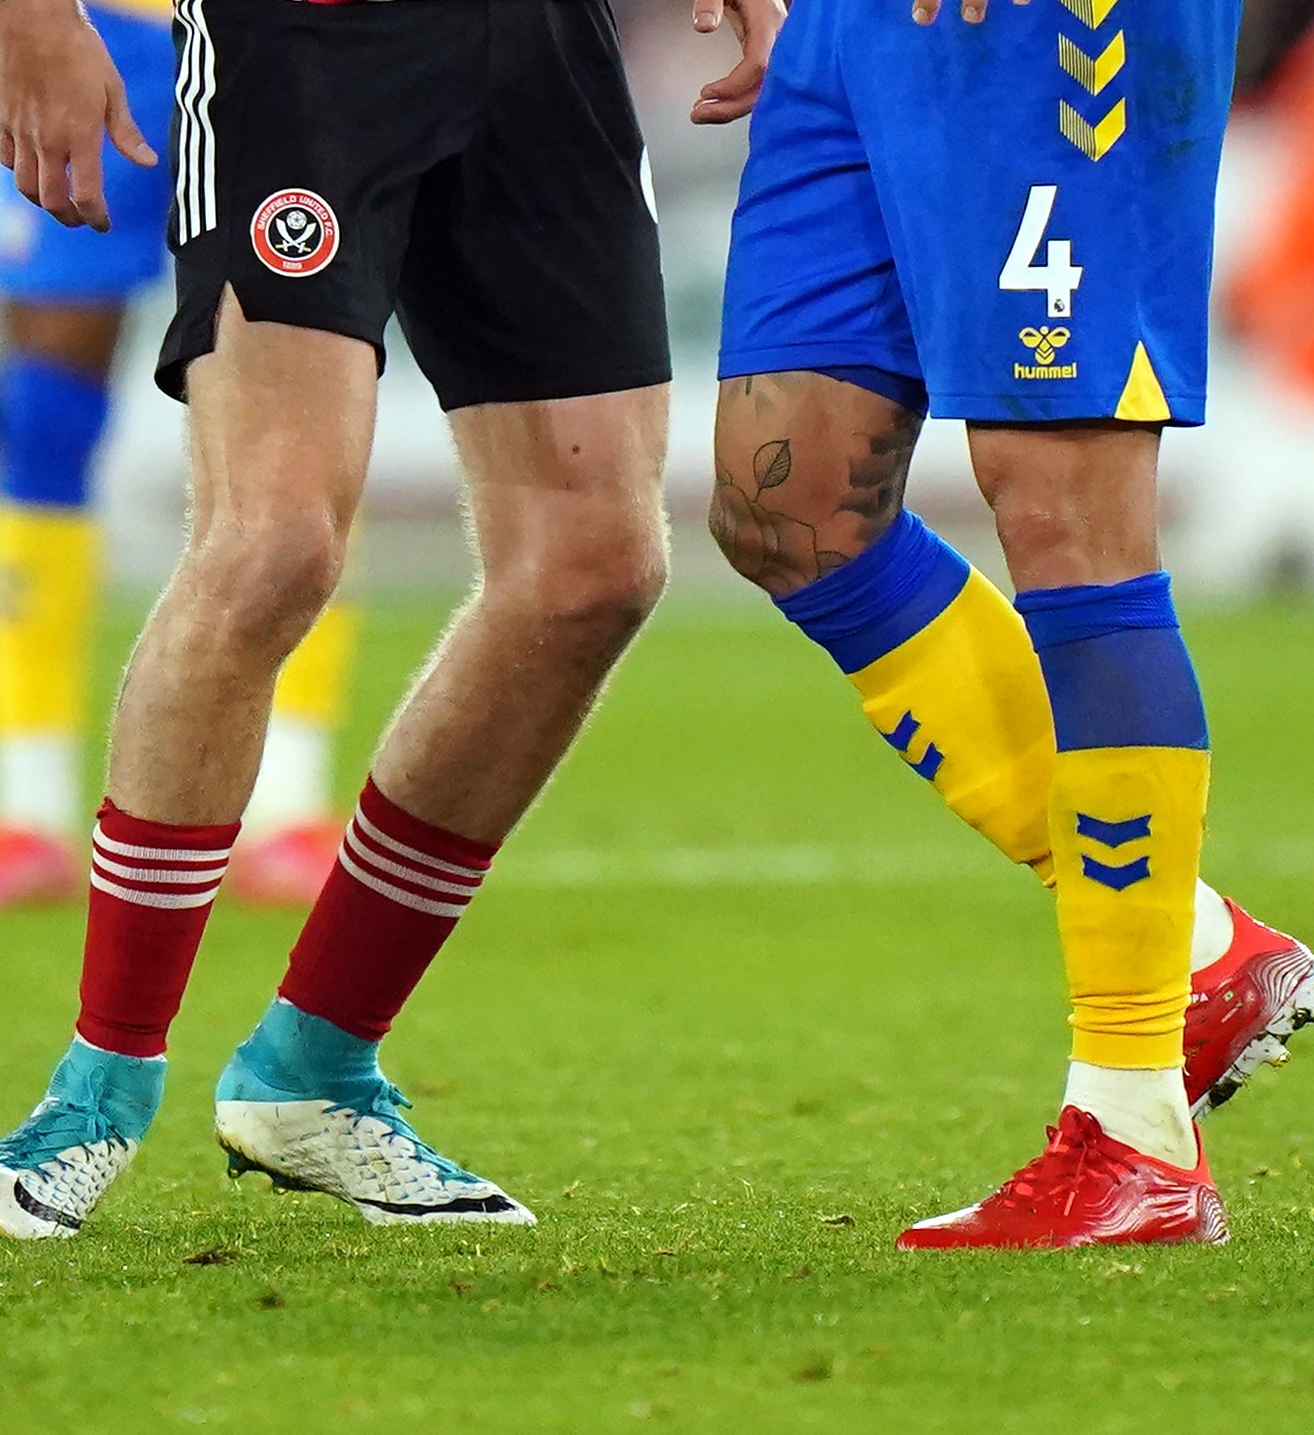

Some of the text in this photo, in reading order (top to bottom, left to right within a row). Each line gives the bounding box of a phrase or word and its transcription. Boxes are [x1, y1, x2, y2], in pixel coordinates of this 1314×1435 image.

[998, 185, 1083, 318] 4
[1013, 362, 1077, 379] hummel
[1191, 992, 1209, 1003] PA
